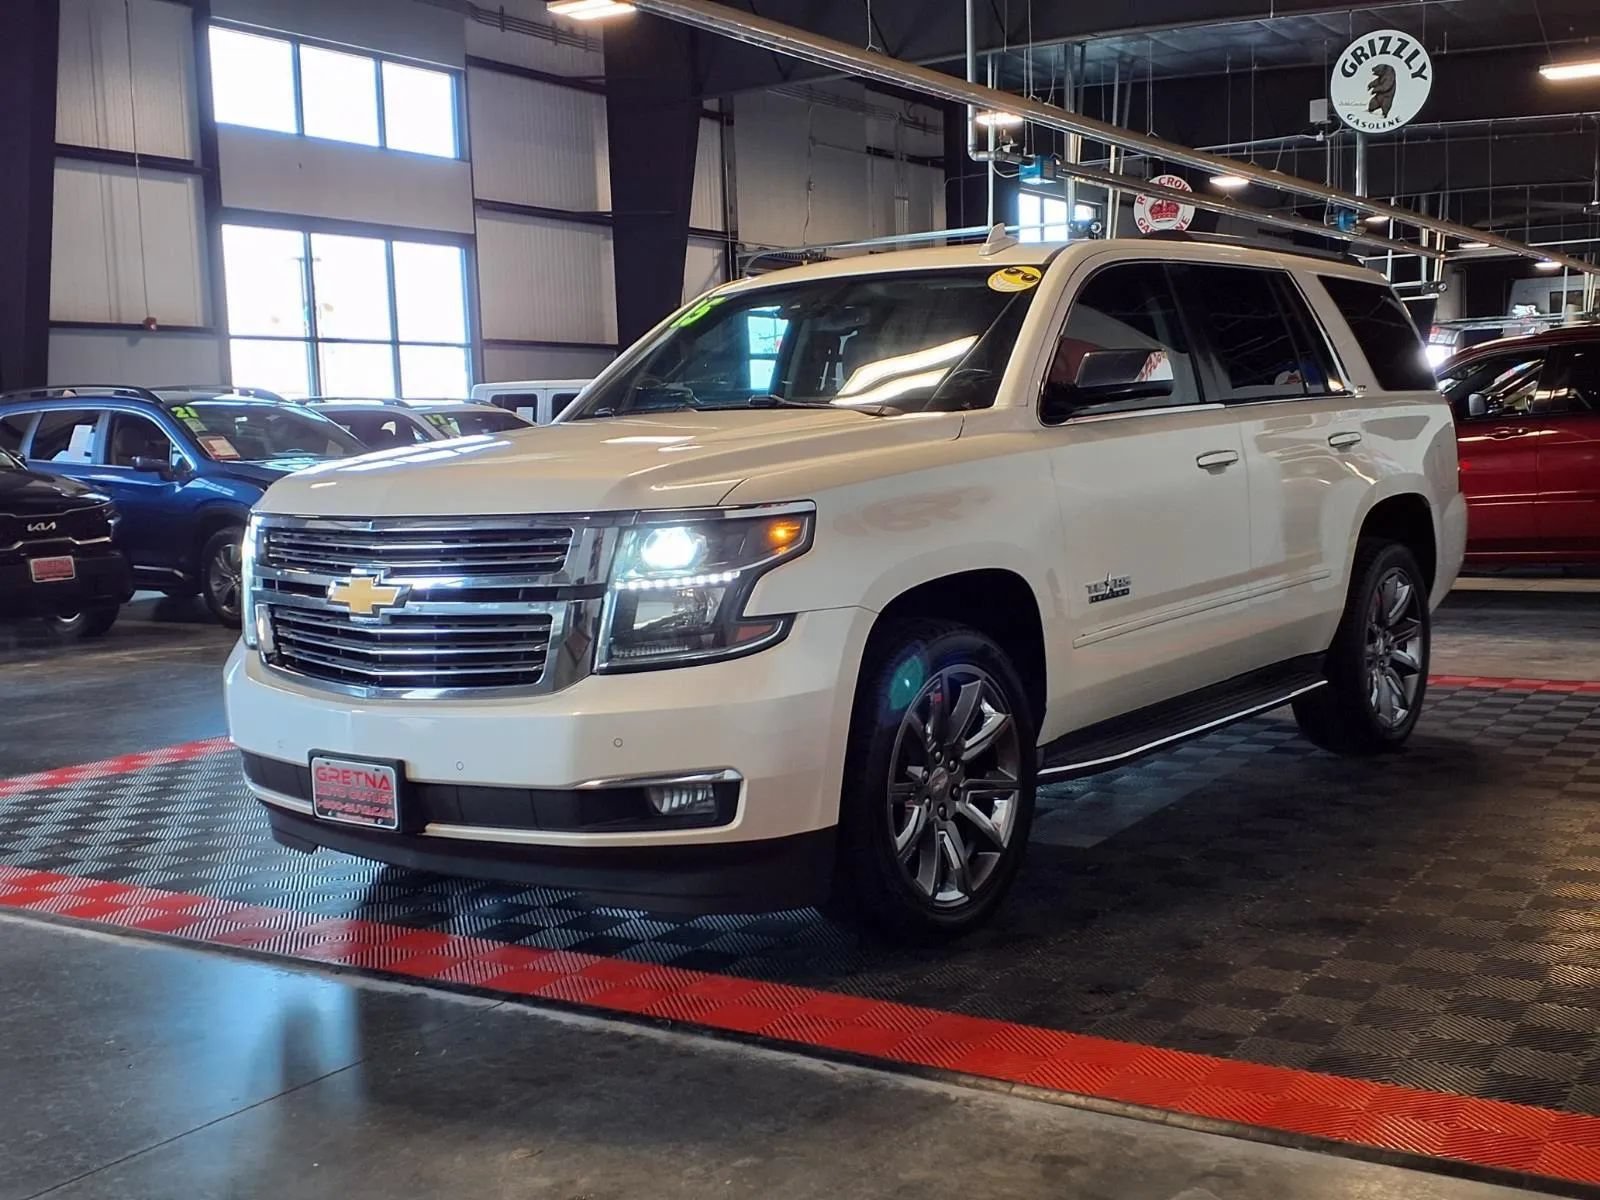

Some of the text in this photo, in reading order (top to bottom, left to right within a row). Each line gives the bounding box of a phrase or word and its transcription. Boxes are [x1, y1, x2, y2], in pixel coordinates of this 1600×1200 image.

[1341, 36, 1428, 81] GRIZZLY
[1346, 113, 1402, 130] GASOLINE
[170, 406, 199, 418] 21
[316, 766, 391, 791] GRETNA
